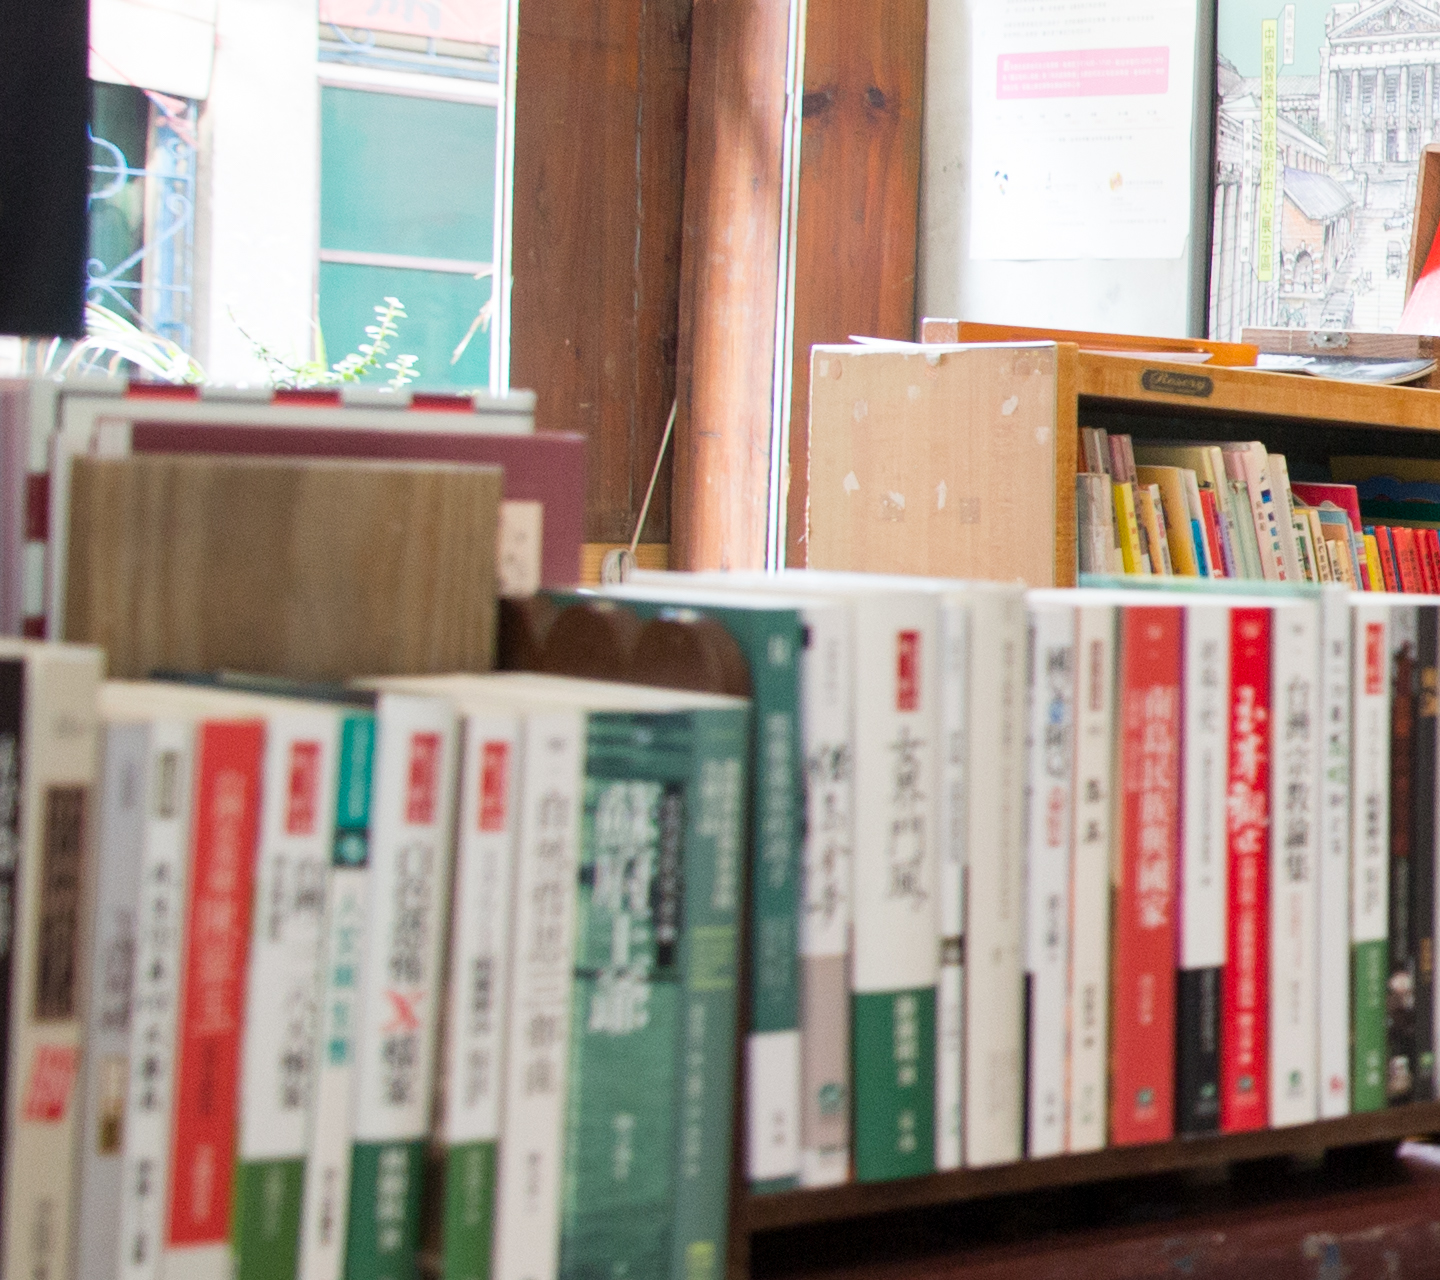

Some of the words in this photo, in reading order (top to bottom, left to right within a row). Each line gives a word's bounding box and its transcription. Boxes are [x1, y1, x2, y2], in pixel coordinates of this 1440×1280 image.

[1260, 25, 1276, 272] 中國醫藥大學藝術中心展示區
